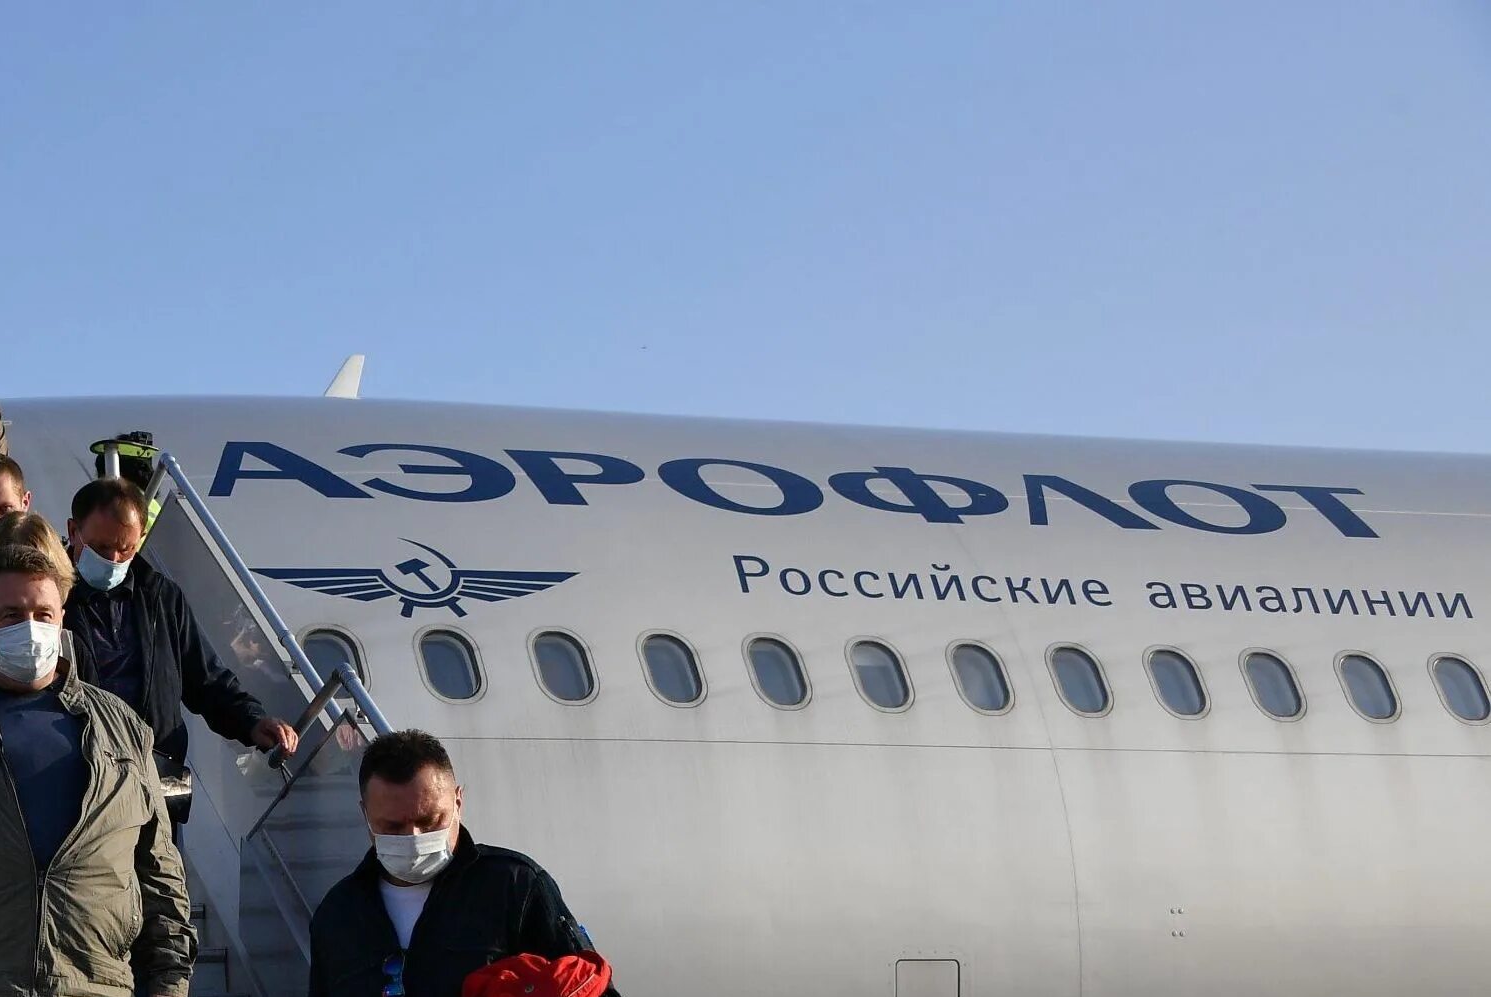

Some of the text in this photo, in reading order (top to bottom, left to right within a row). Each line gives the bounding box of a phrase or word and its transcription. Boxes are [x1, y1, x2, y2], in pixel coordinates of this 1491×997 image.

[208, 441, 1380, 538] АЭРОФЛОТ
[733, 555, 1474, 619] Российские авиалинии
